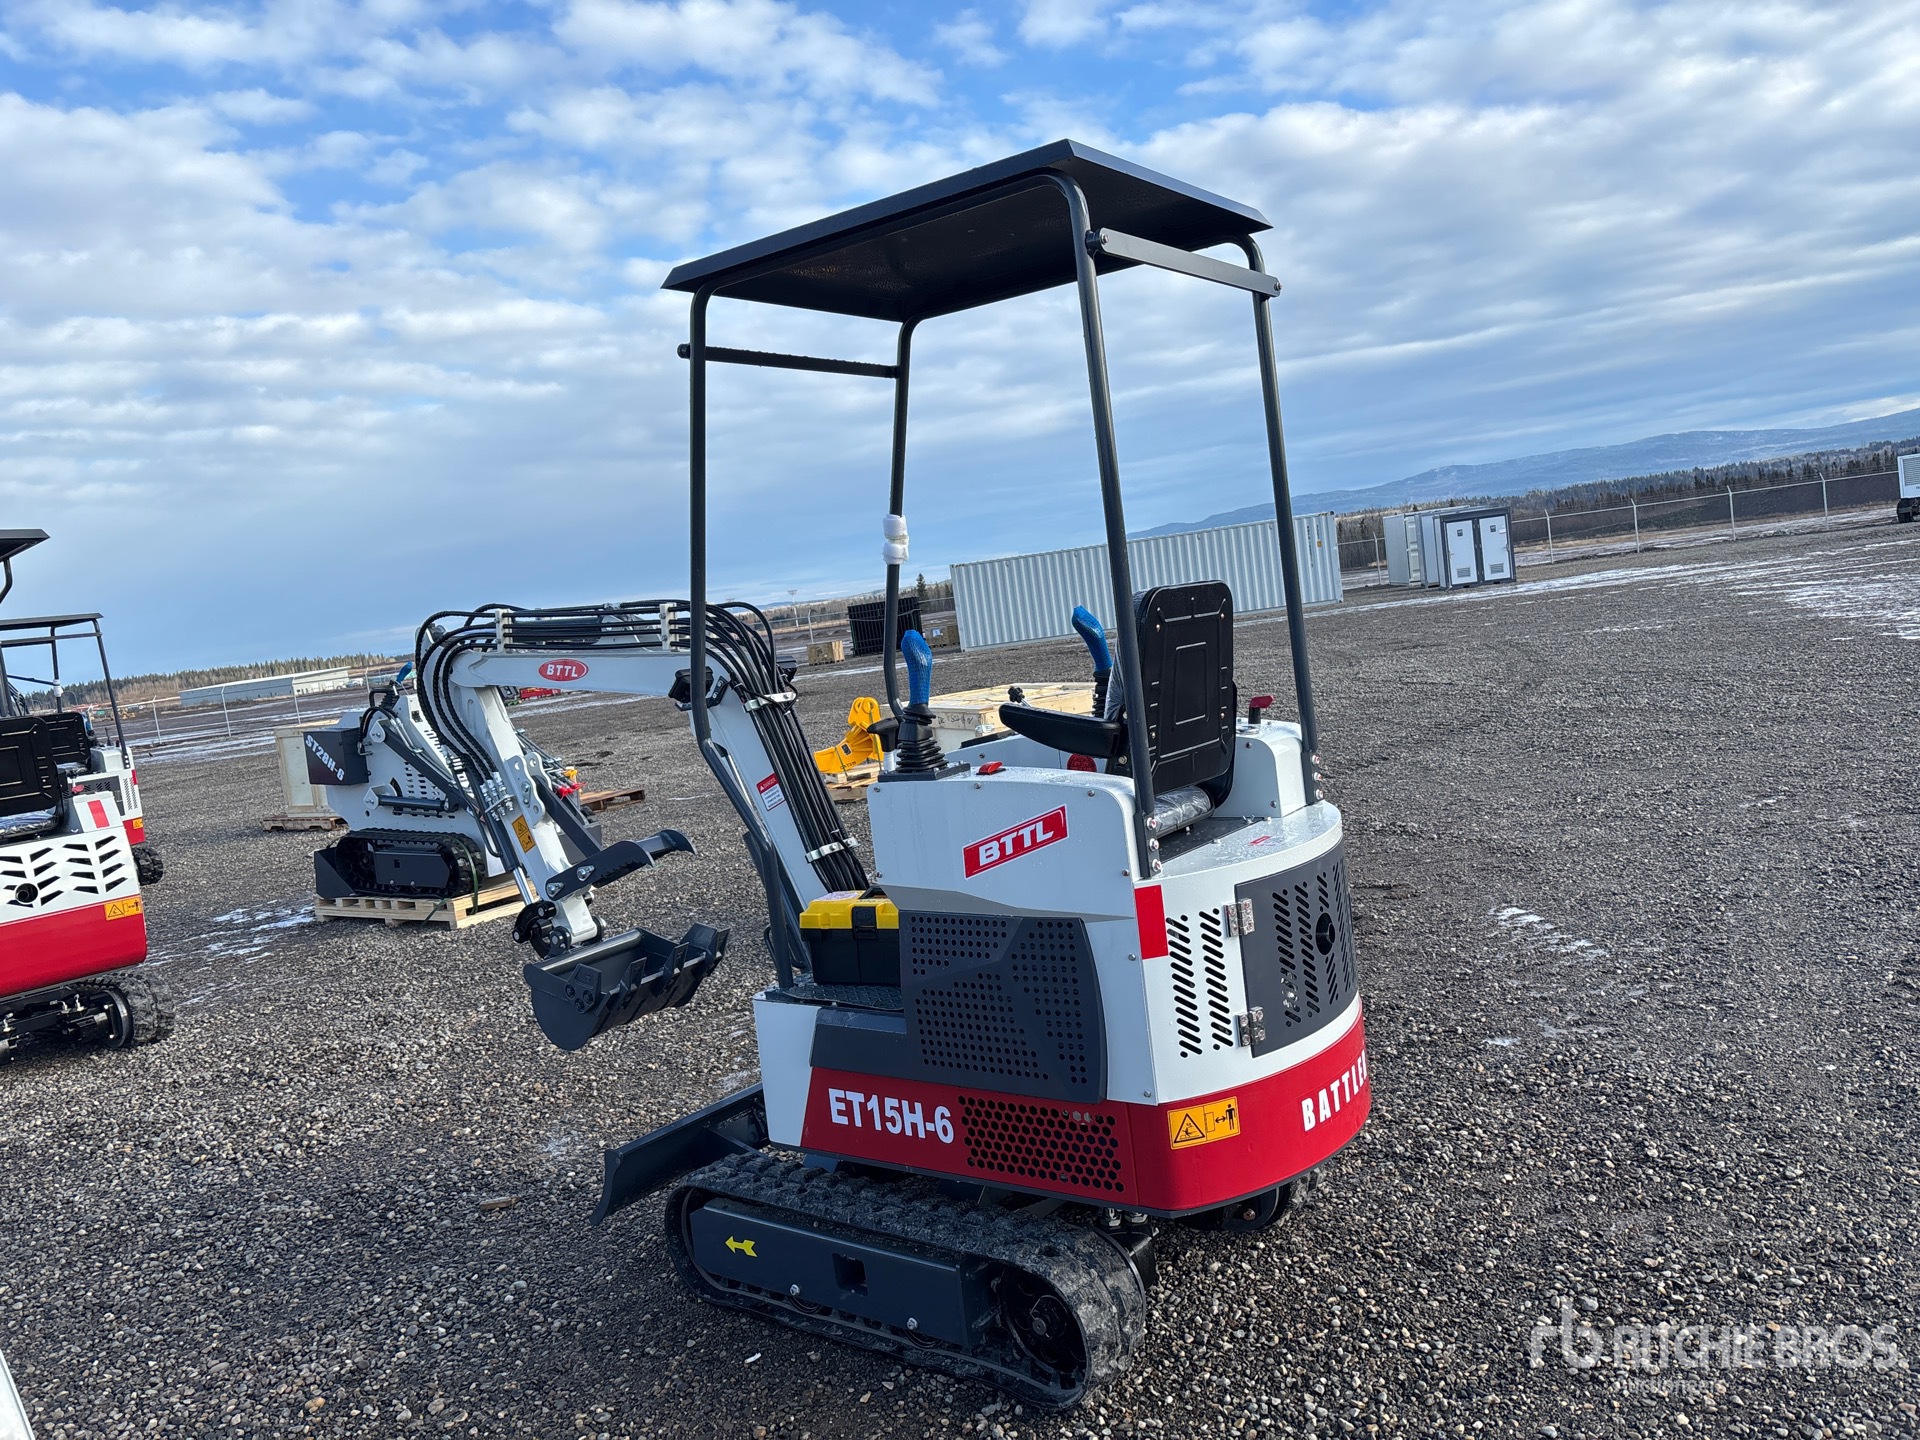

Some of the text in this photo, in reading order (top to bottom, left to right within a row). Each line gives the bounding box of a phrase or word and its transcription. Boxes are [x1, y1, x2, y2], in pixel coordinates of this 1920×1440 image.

[546, 664, 578, 678] BTTL
[305, 734, 345, 781] ST28H-6
[979, 821, 1055, 867] BTTL
[828, 1087, 955, 1144] ET15H-6
